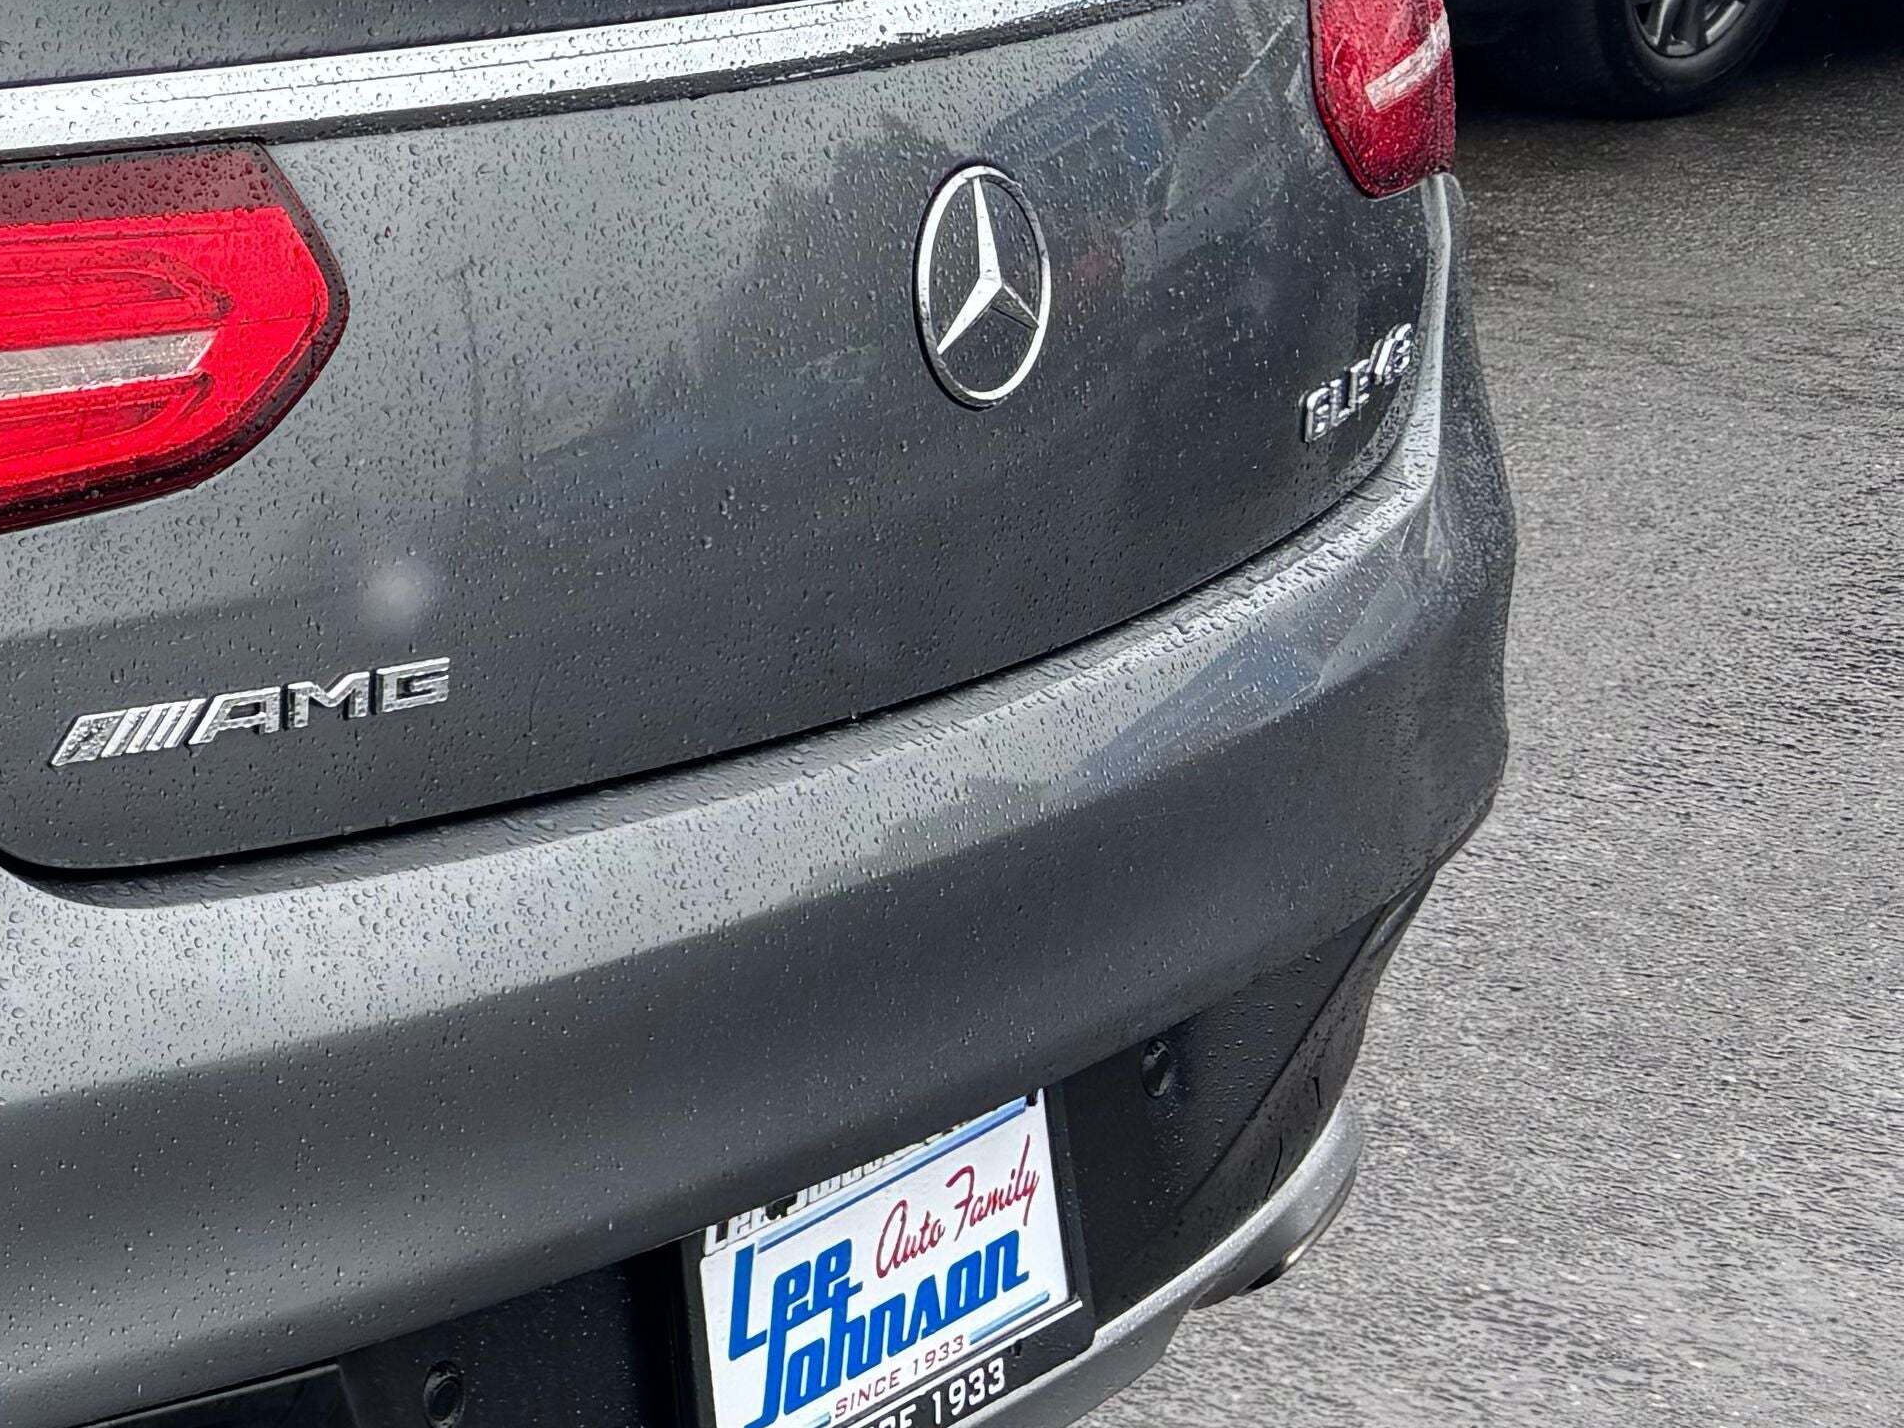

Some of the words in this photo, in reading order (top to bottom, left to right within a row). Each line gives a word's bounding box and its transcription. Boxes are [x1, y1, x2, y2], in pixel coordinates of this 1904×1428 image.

[187, 656, 452, 747] AMG
[875, 1198, 947, 1280] Auto
[945, 1133, 1041, 1243] Family
[728, 1237, 856, 1361] Lee
[833, 1368, 901, 1418] SINCE
[911, 1334, 966, 1380] 1933
[930, 1356, 1007, 1428] 1933
